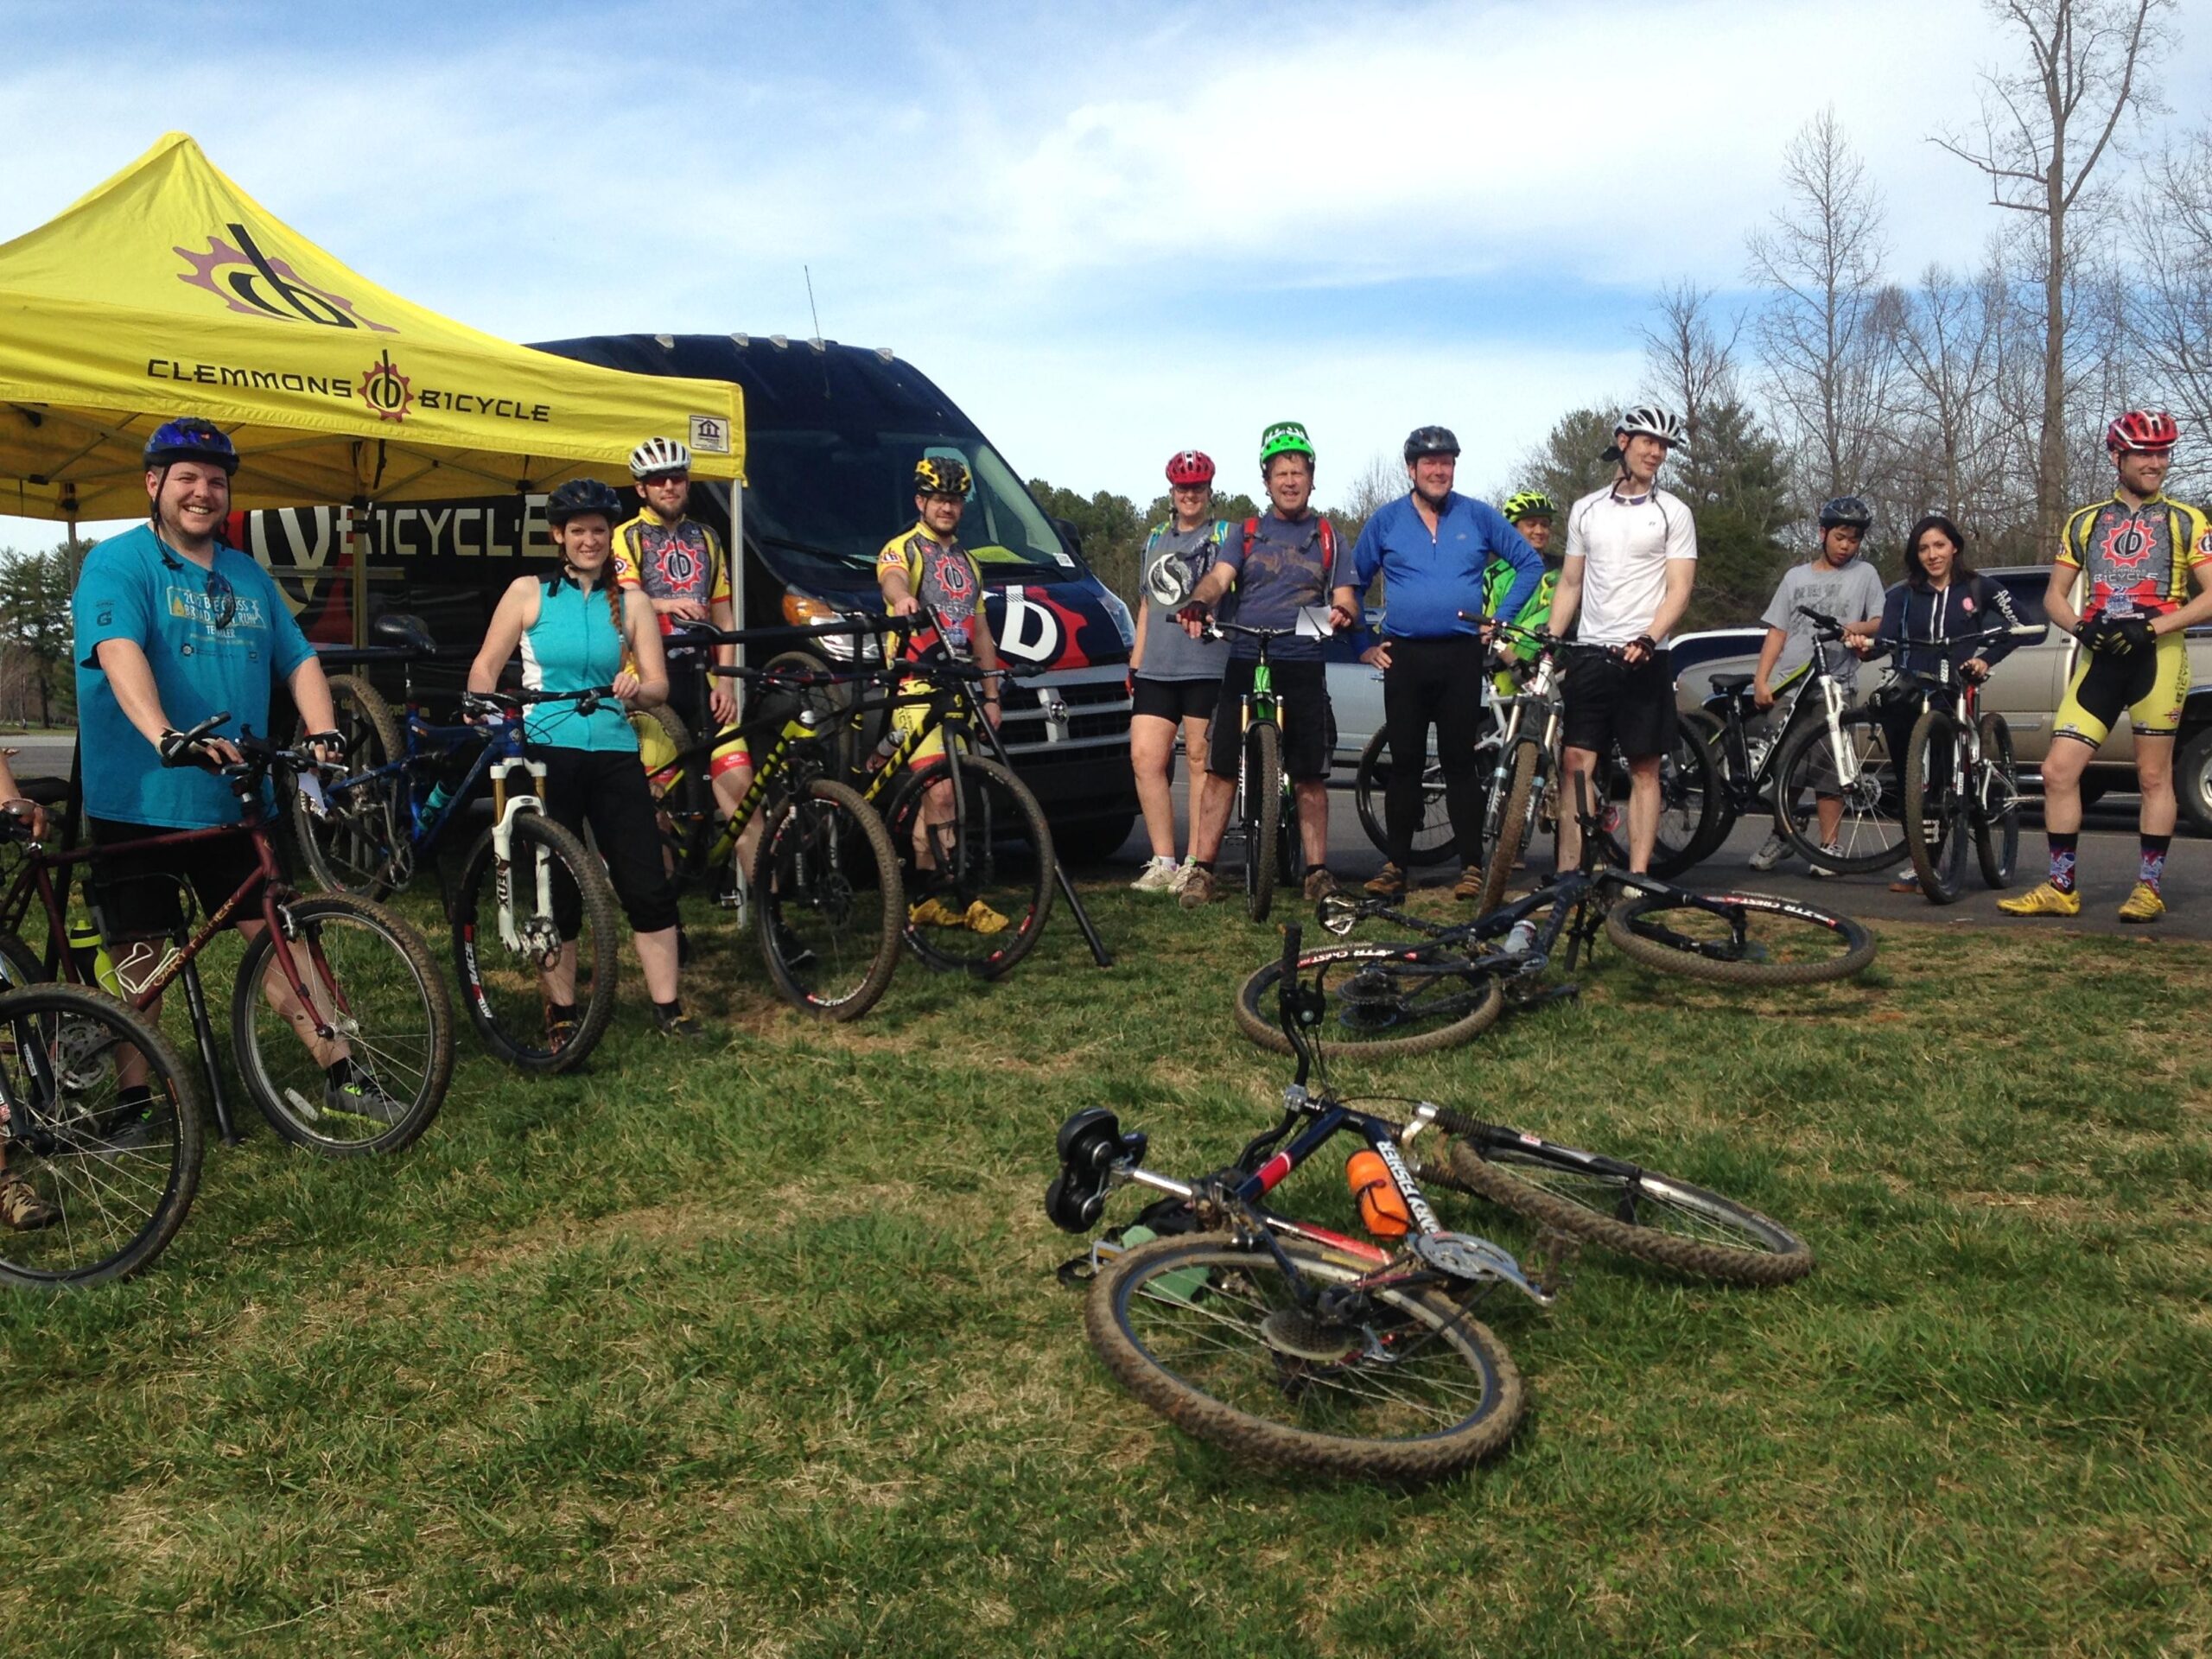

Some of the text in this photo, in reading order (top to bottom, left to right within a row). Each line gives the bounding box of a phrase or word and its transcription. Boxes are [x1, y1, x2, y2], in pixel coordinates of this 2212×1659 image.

[147, 359, 353, 398] CLEMMONS
[418, 389, 551, 423] BICYCLE
[154, 951, 187, 987] GARY
[1376, 1140, 1421, 1200] FISHER
